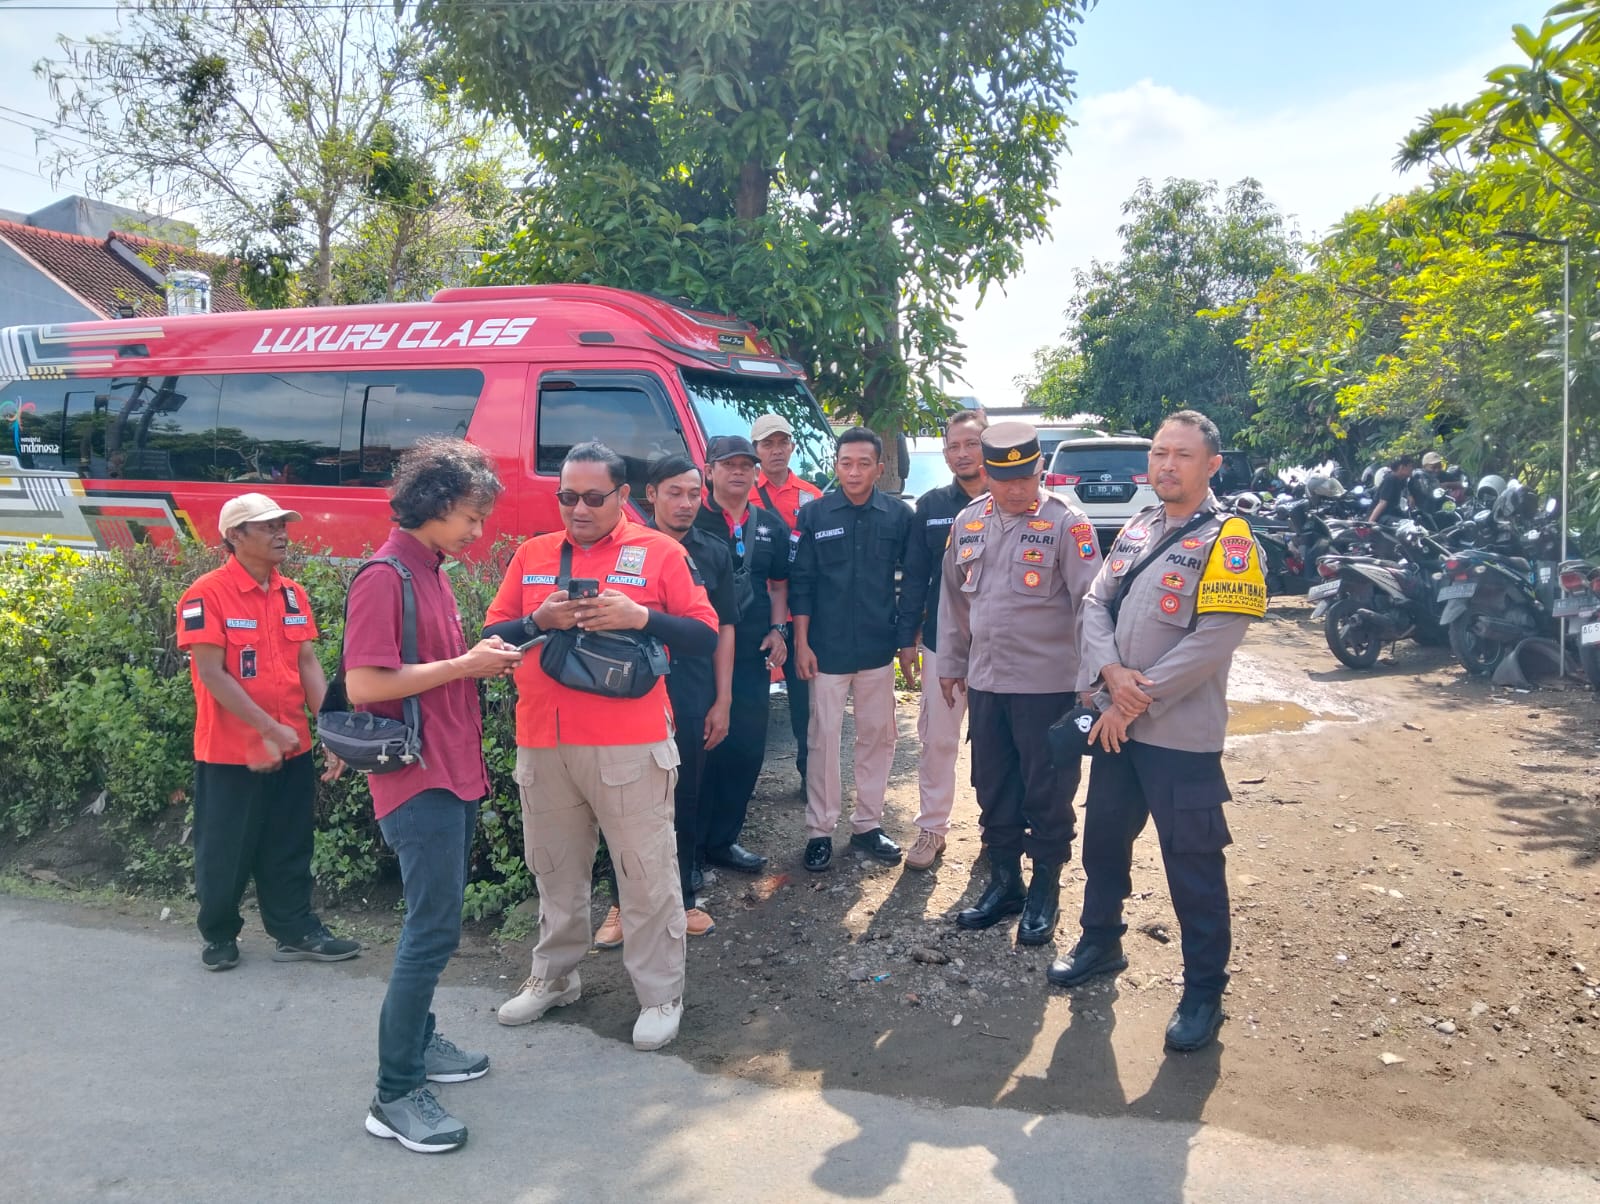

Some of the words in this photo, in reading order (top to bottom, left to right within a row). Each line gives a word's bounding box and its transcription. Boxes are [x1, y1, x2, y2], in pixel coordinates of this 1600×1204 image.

[251, 322, 399, 353] LUXURY
[397, 317, 537, 349] CLASS
[1020, 534, 1054, 545] POLRI
[1165, 553, 1202, 570] POLRI
[1202, 582, 1264, 599] BHABINKAMTIBMAS
